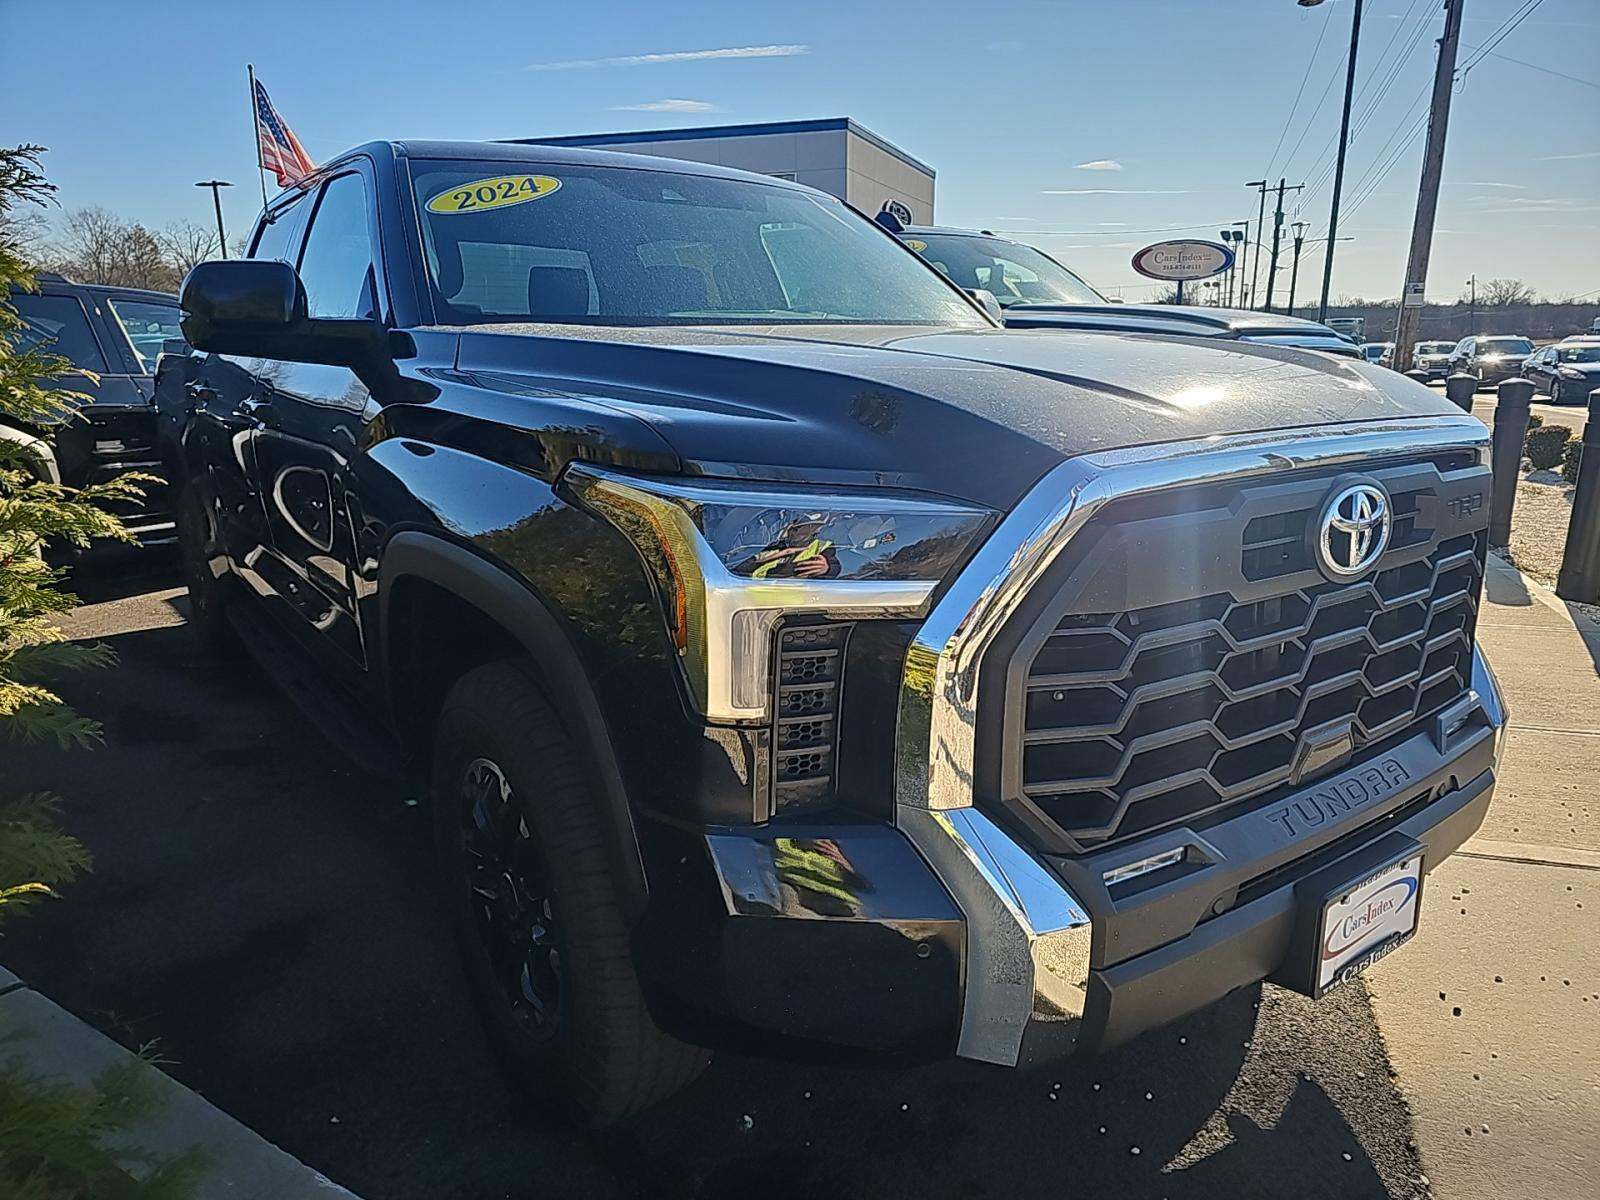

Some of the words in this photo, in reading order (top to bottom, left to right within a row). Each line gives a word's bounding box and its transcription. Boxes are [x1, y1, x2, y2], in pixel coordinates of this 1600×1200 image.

[453, 177, 541, 210] 2024
[1154, 249, 1202, 264] CarsIndex
[1447, 493, 1482, 520] TRD
[1264, 758, 1411, 838] TUNDRA
[1342, 897, 1395, 939] CarsIndex
